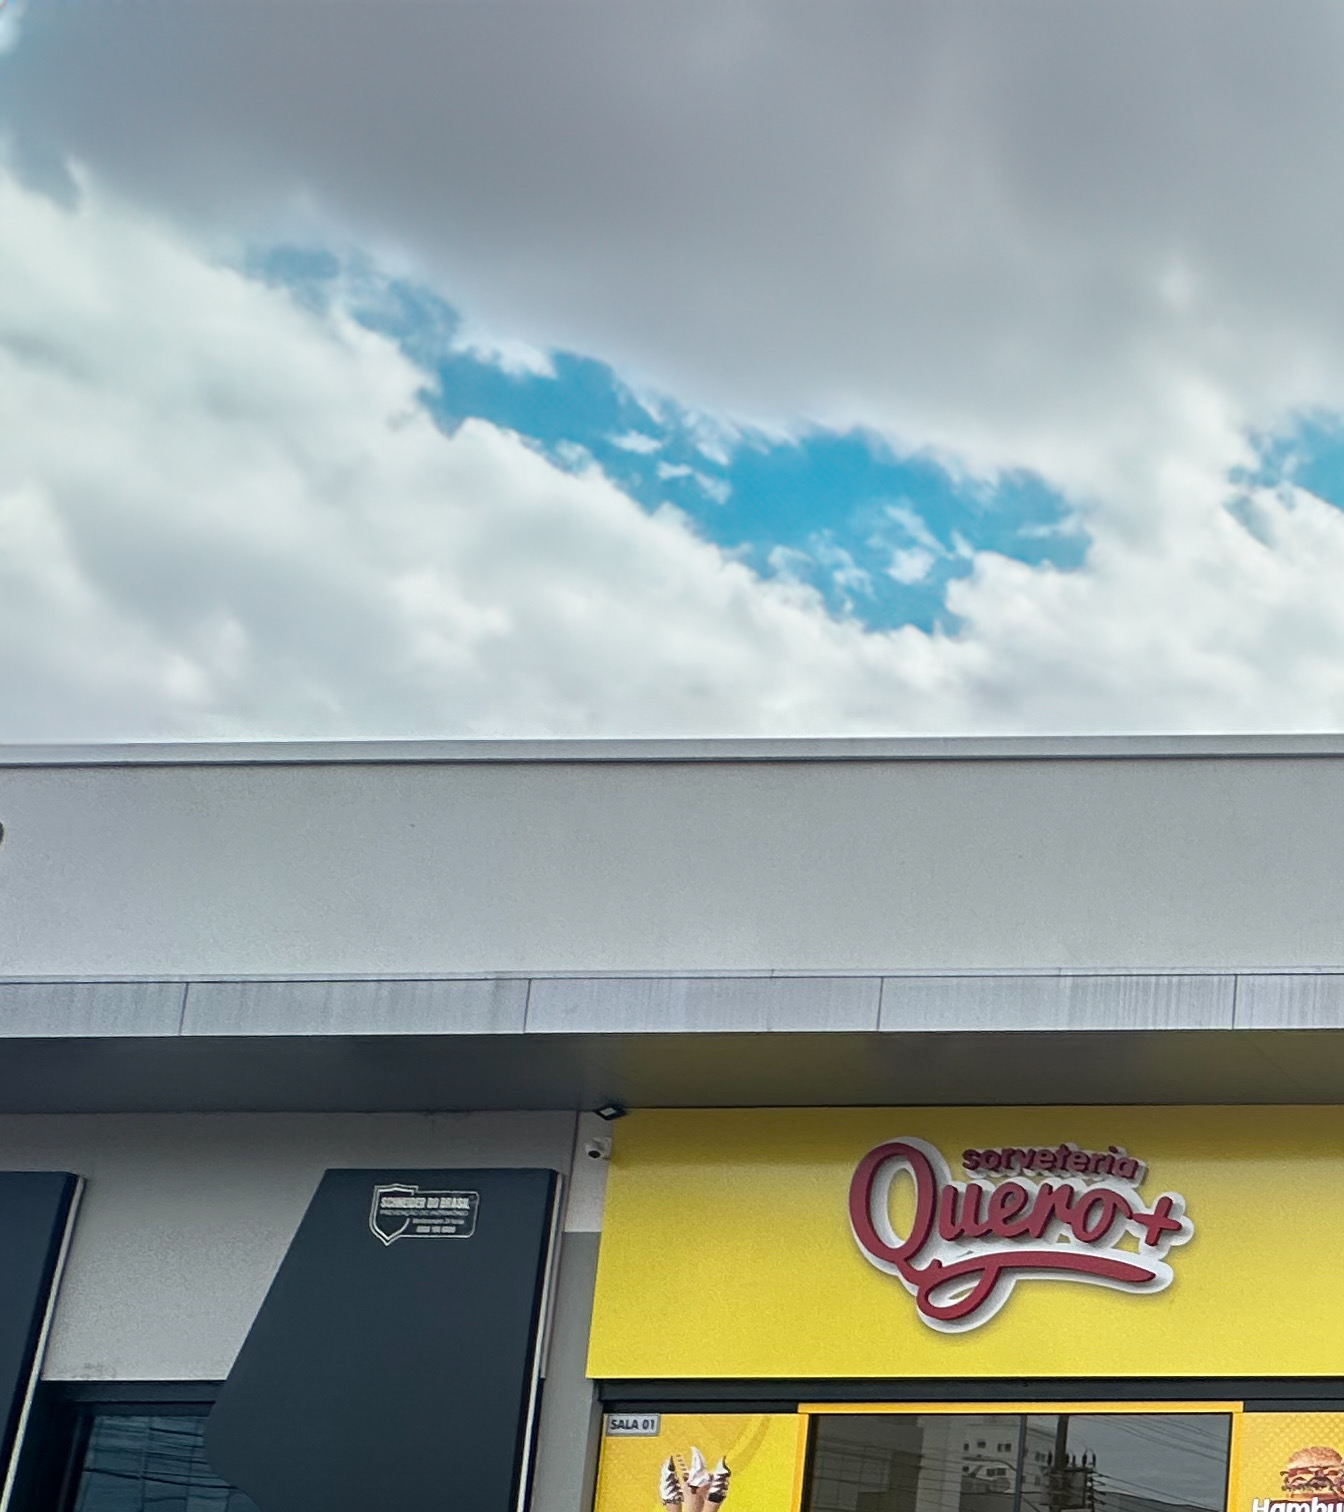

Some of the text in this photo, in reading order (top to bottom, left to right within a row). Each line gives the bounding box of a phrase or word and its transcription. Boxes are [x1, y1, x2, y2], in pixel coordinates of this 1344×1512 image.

[961, 1142, 1142, 1180] sorveteria
[610, 1418, 655, 1431] SALA 01
